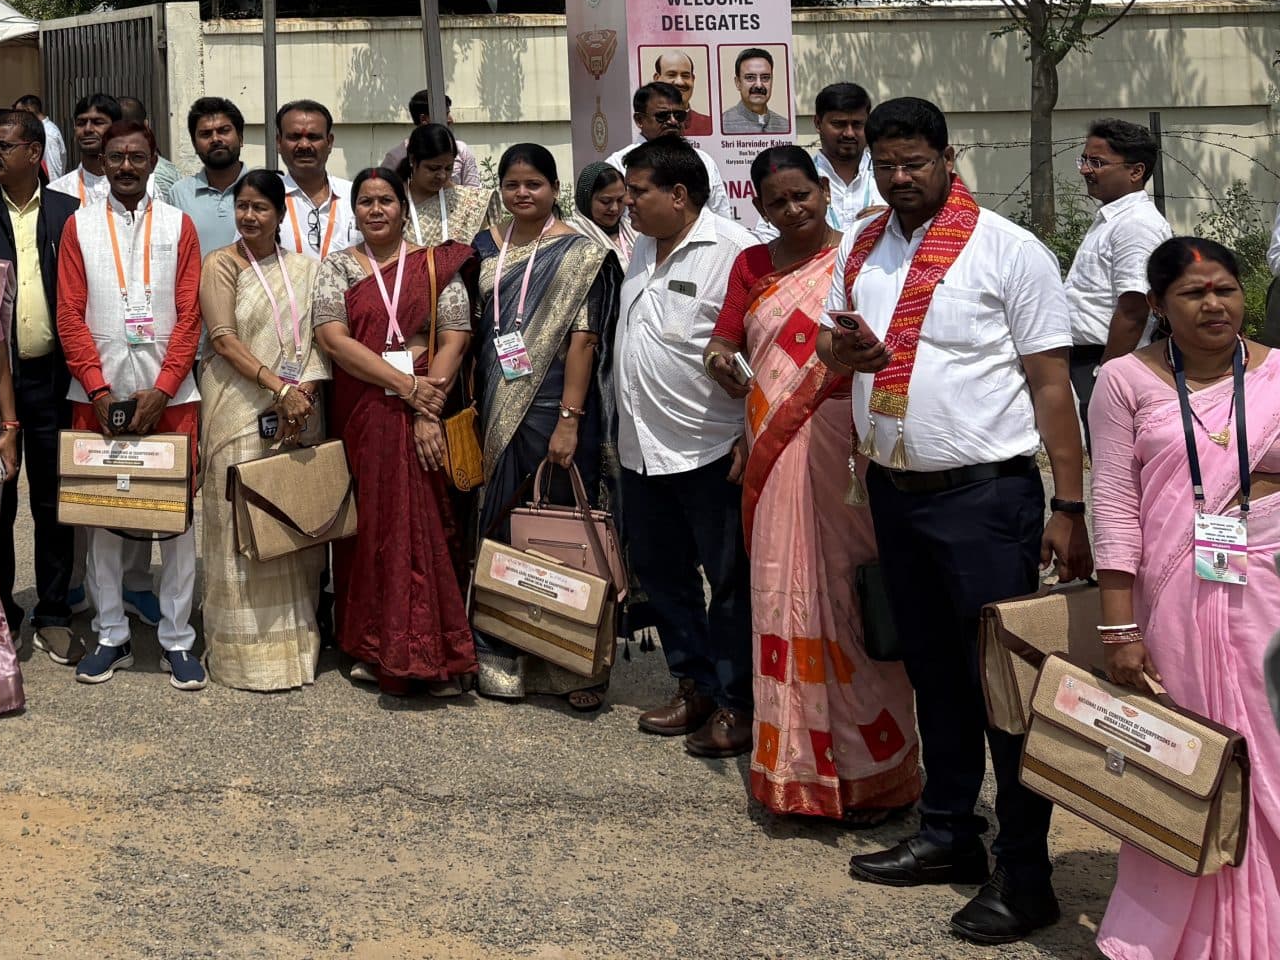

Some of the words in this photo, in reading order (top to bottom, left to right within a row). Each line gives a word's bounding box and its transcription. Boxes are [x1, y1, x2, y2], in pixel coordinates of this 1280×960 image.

[661, 14, 761, 31] DELEGATES
[721, 141, 735, 149] Shri
[736, 140, 768, 148] Harvinder
